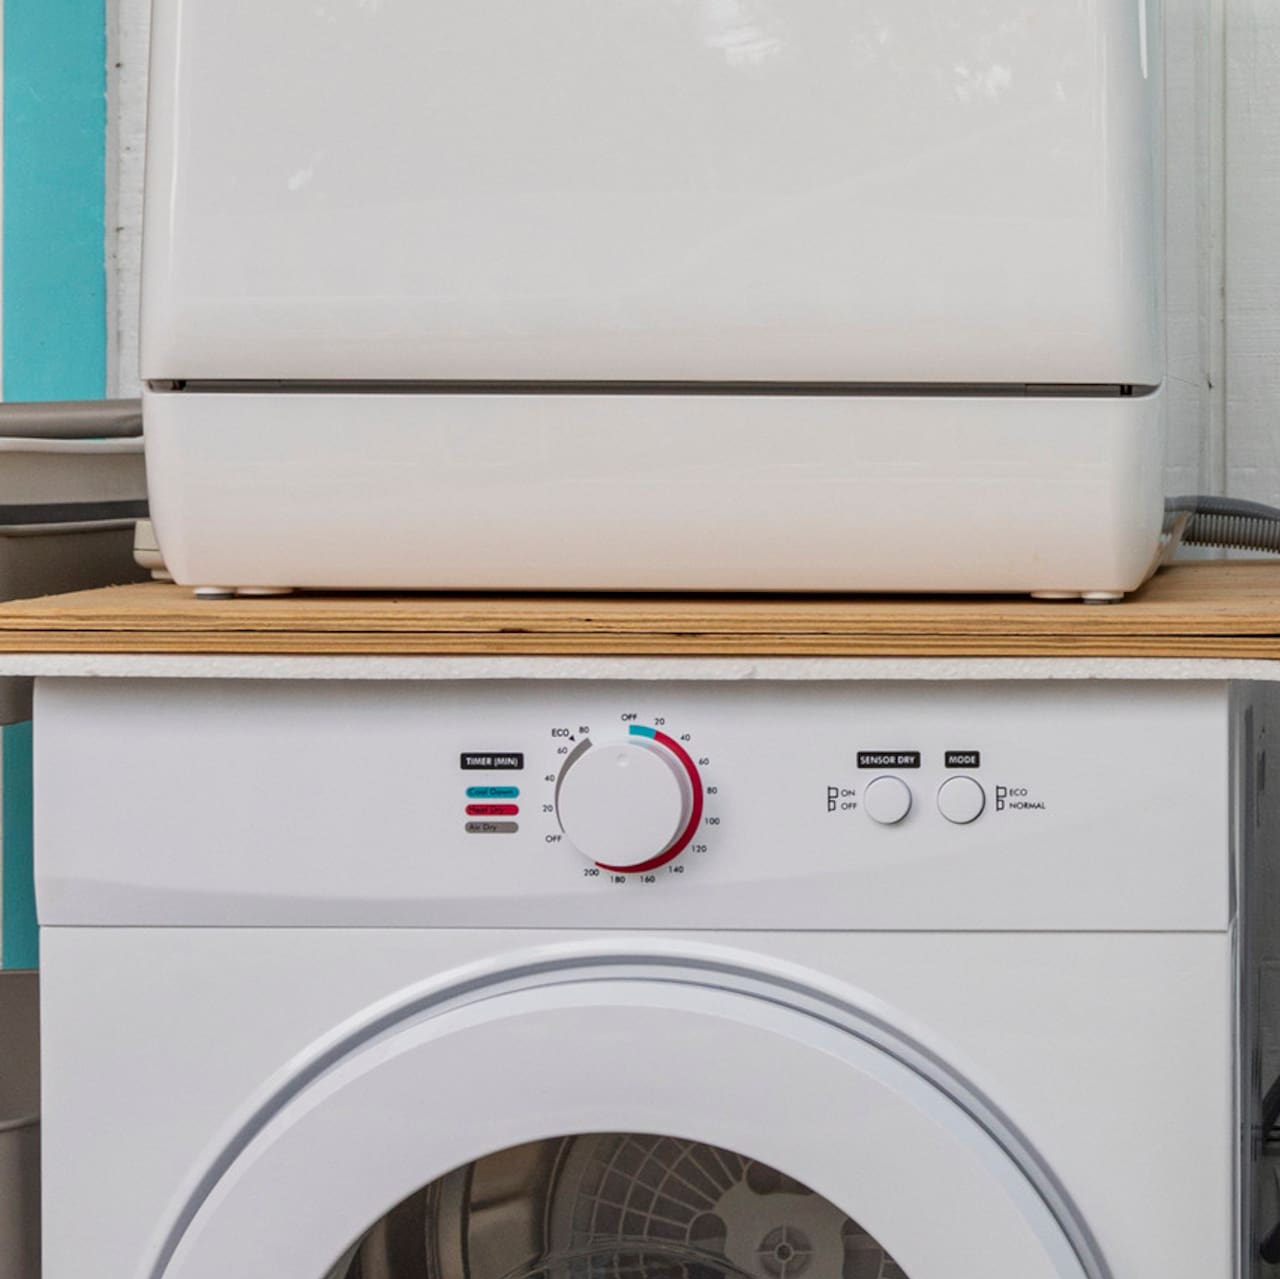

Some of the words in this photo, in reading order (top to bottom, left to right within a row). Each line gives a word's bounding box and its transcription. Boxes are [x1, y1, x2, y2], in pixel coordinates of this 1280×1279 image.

[552, 729, 569, 737] ECO
[579, 726, 589, 734] 80
[466, 757, 492, 766] TIMER
[494, 757, 518, 767] (MIN)
[699, 758, 709, 766] 60
[860, 755, 896, 764] SENSOR
[897, 755, 915, 764] DRY
[949, 755, 976, 764] MODE
[841, 789, 855, 797] ON
[1009, 789, 1027, 797] ECO
[841, 802, 857, 810] OFF
[1009, 802, 1046, 810] NORMAL
